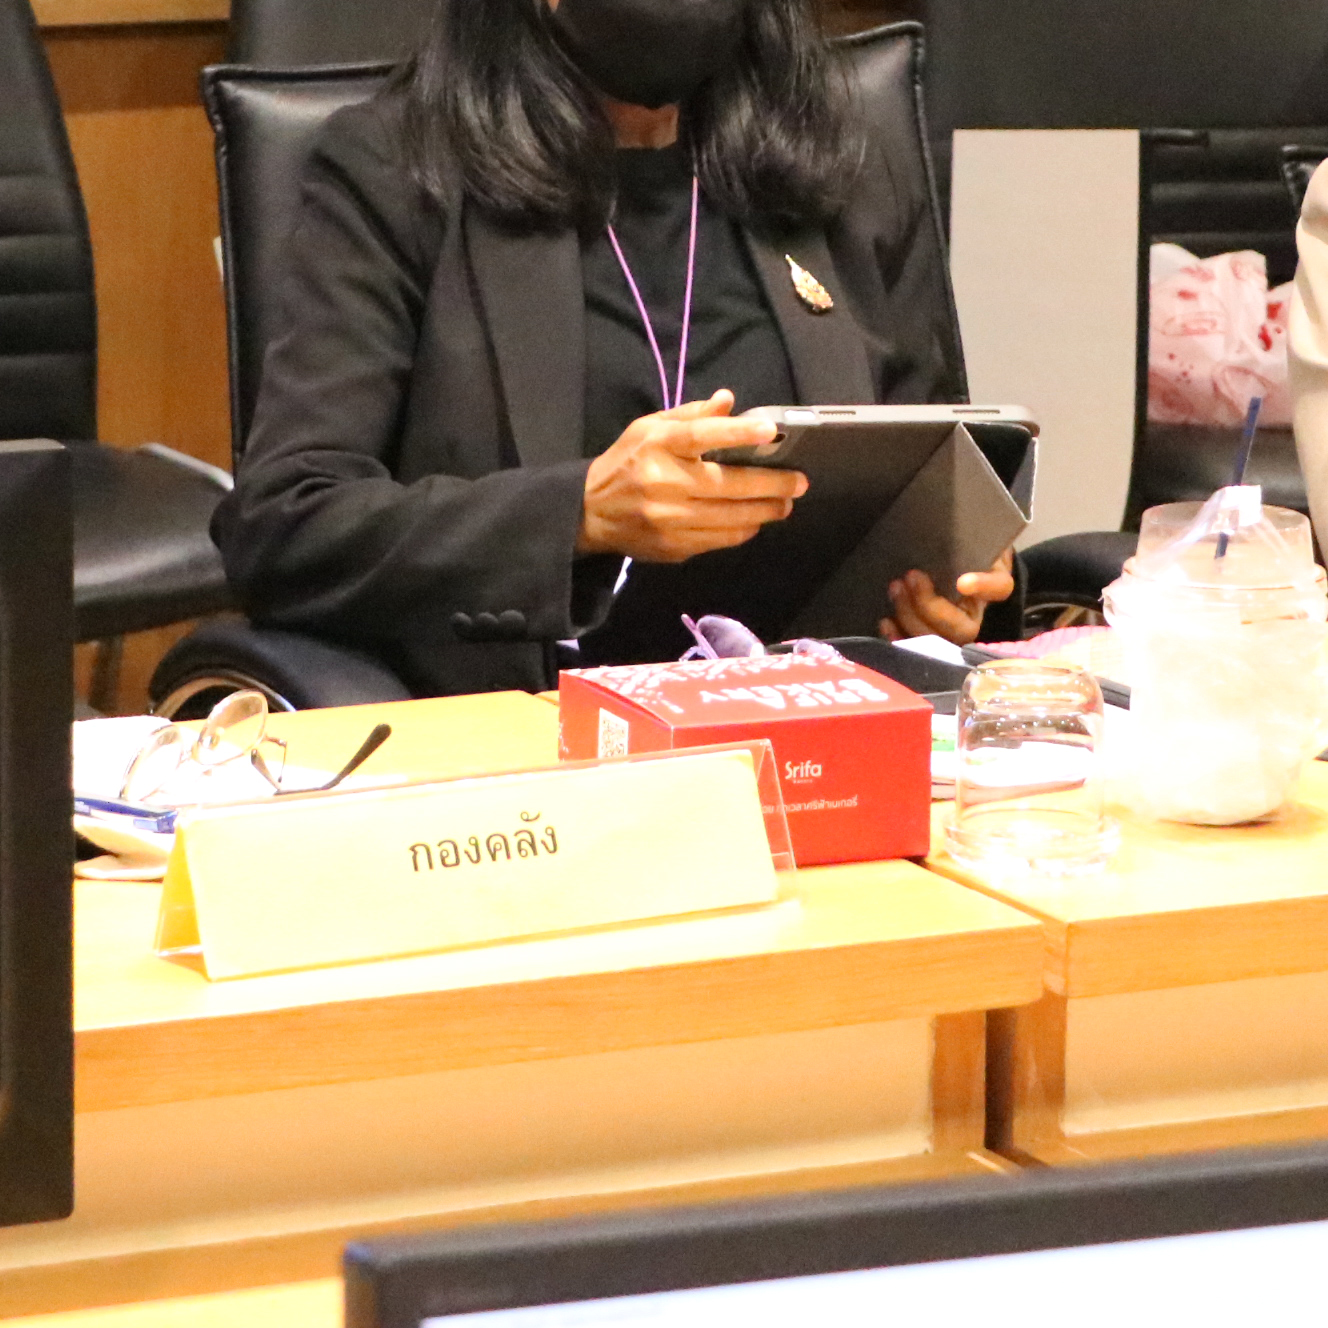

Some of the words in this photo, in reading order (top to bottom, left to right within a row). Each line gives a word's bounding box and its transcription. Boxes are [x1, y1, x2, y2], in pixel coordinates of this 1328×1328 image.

[784, 759, 823, 780] Srifa
[408, 811, 559, 873] กองคลัง
